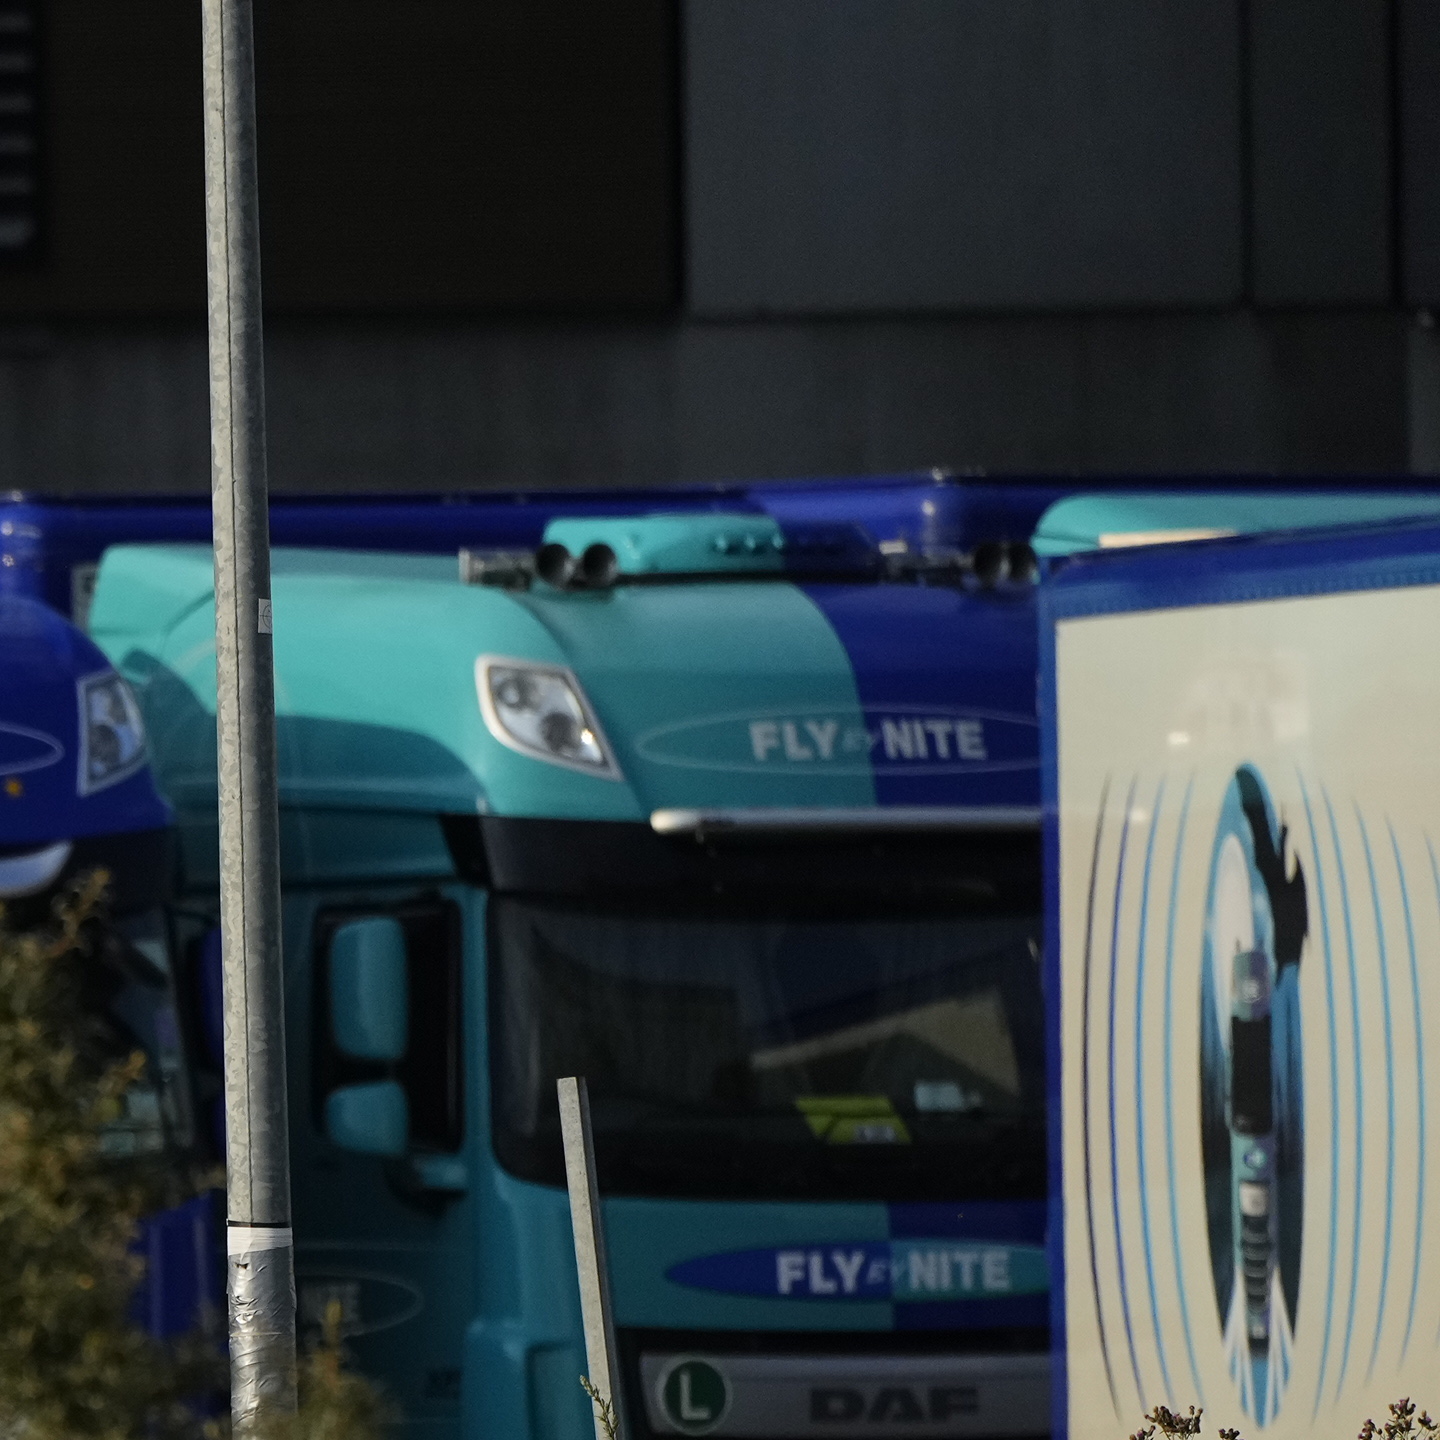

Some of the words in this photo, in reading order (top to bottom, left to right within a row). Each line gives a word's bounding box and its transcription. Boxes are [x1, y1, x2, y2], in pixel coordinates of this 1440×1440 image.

[750, 719, 837, 761] FLY
[881, 718, 987, 761] NITE
[775, 1250, 865, 1294] FLY
[909, 1251, 1011, 1292] NITE
[679, 1369, 710, 1420] L
[809, 1386, 979, 1424] DAF
